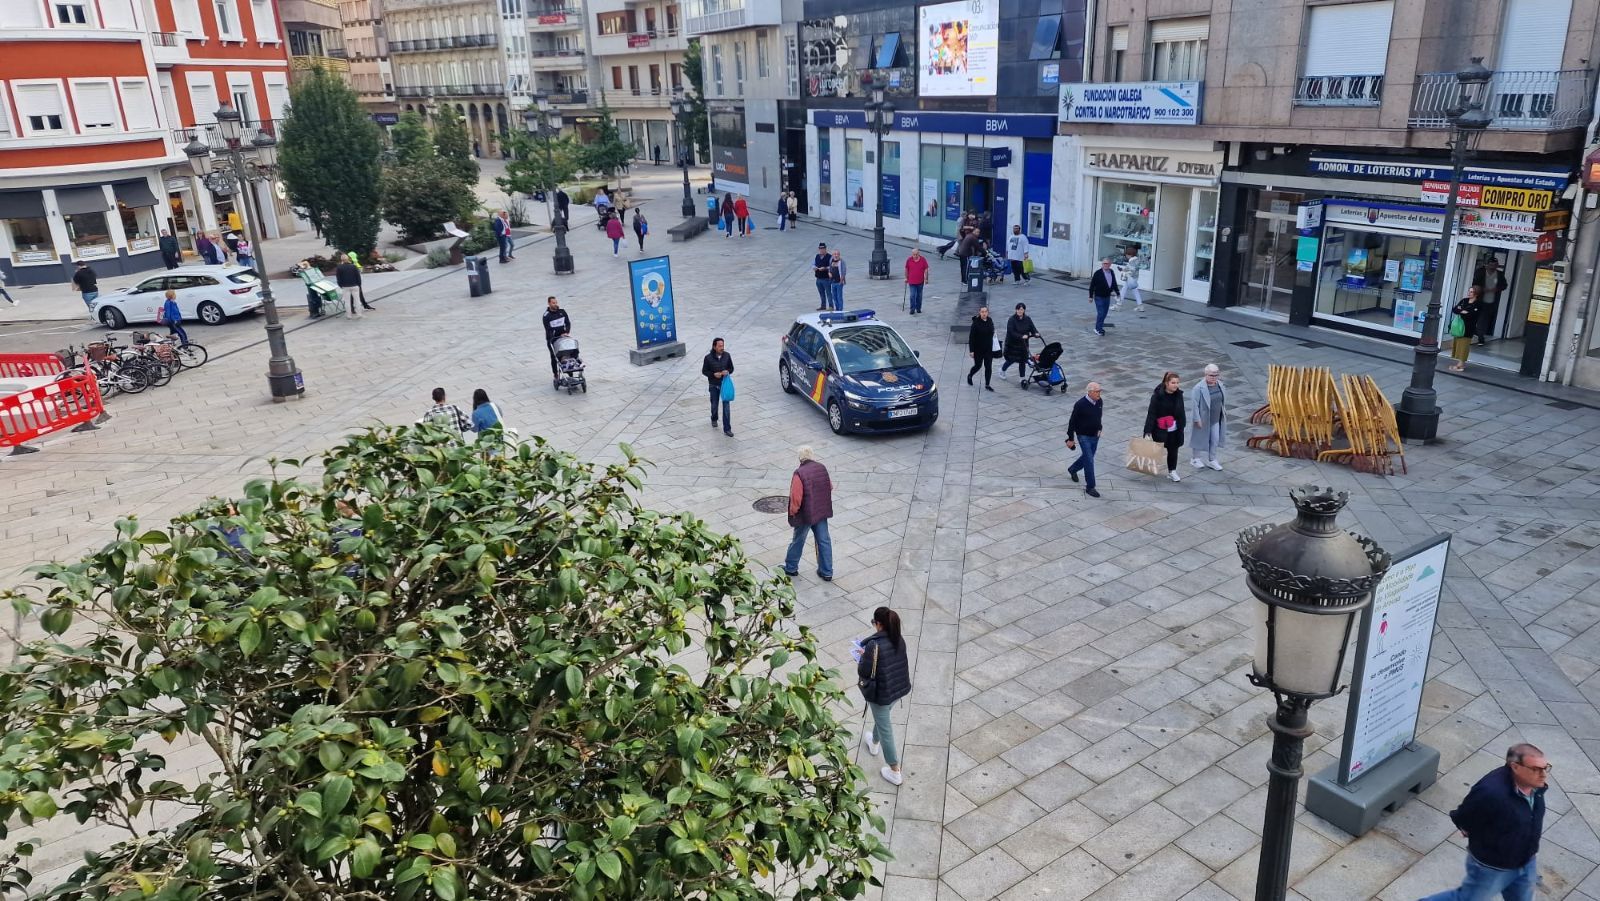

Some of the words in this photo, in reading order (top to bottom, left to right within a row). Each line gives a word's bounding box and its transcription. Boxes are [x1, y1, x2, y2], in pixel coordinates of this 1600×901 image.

[1084, 86, 1117, 101] FUNDACIÓN
[1118, 89, 1142, 102] GALEGA
[1075, 106, 1097, 118] CONTRA
[1098, 106, 1103, 118] O
[1104, 103, 1150, 120] NARCOTRÁFICO
[1154, 108, 1166, 117] 900
[835, 115, 850, 125] BBVA
[901, 117, 918, 128] BBVA
[985, 119, 1008, 131] BBVA
[1353, 164, 1365, 174] DE
[1429, 169, 1435, 179] 1
[1497, 175, 1522, 184] Apuestas
[1523, 177, 1534, 185] del
[1535, 178, 1556, 187] Estado
[1456, 195, 1479, 206] Santi
[1484, 189, 1526, 208] COMPRO
[1528, 192, 1549, 210] ORO
[1380, 212, 1407, 221] Apuestas
[1419, 216, 1440, 224] Estado
